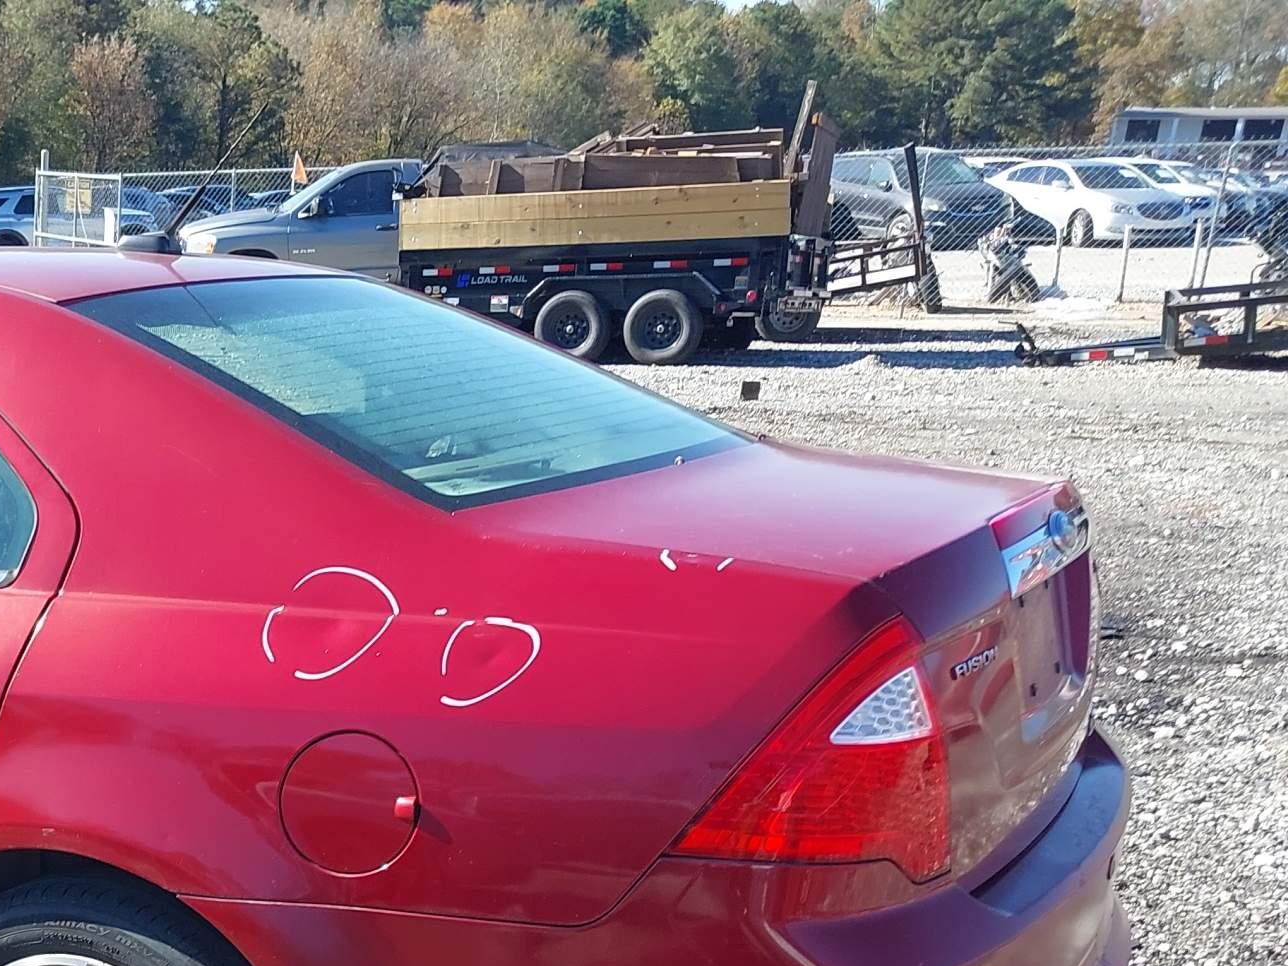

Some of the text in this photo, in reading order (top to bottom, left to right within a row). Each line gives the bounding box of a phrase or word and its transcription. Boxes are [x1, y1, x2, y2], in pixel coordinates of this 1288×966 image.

[470, 275, 528, 285] LOAD TRAIL
[952, 645, 998, 678] FUSION
